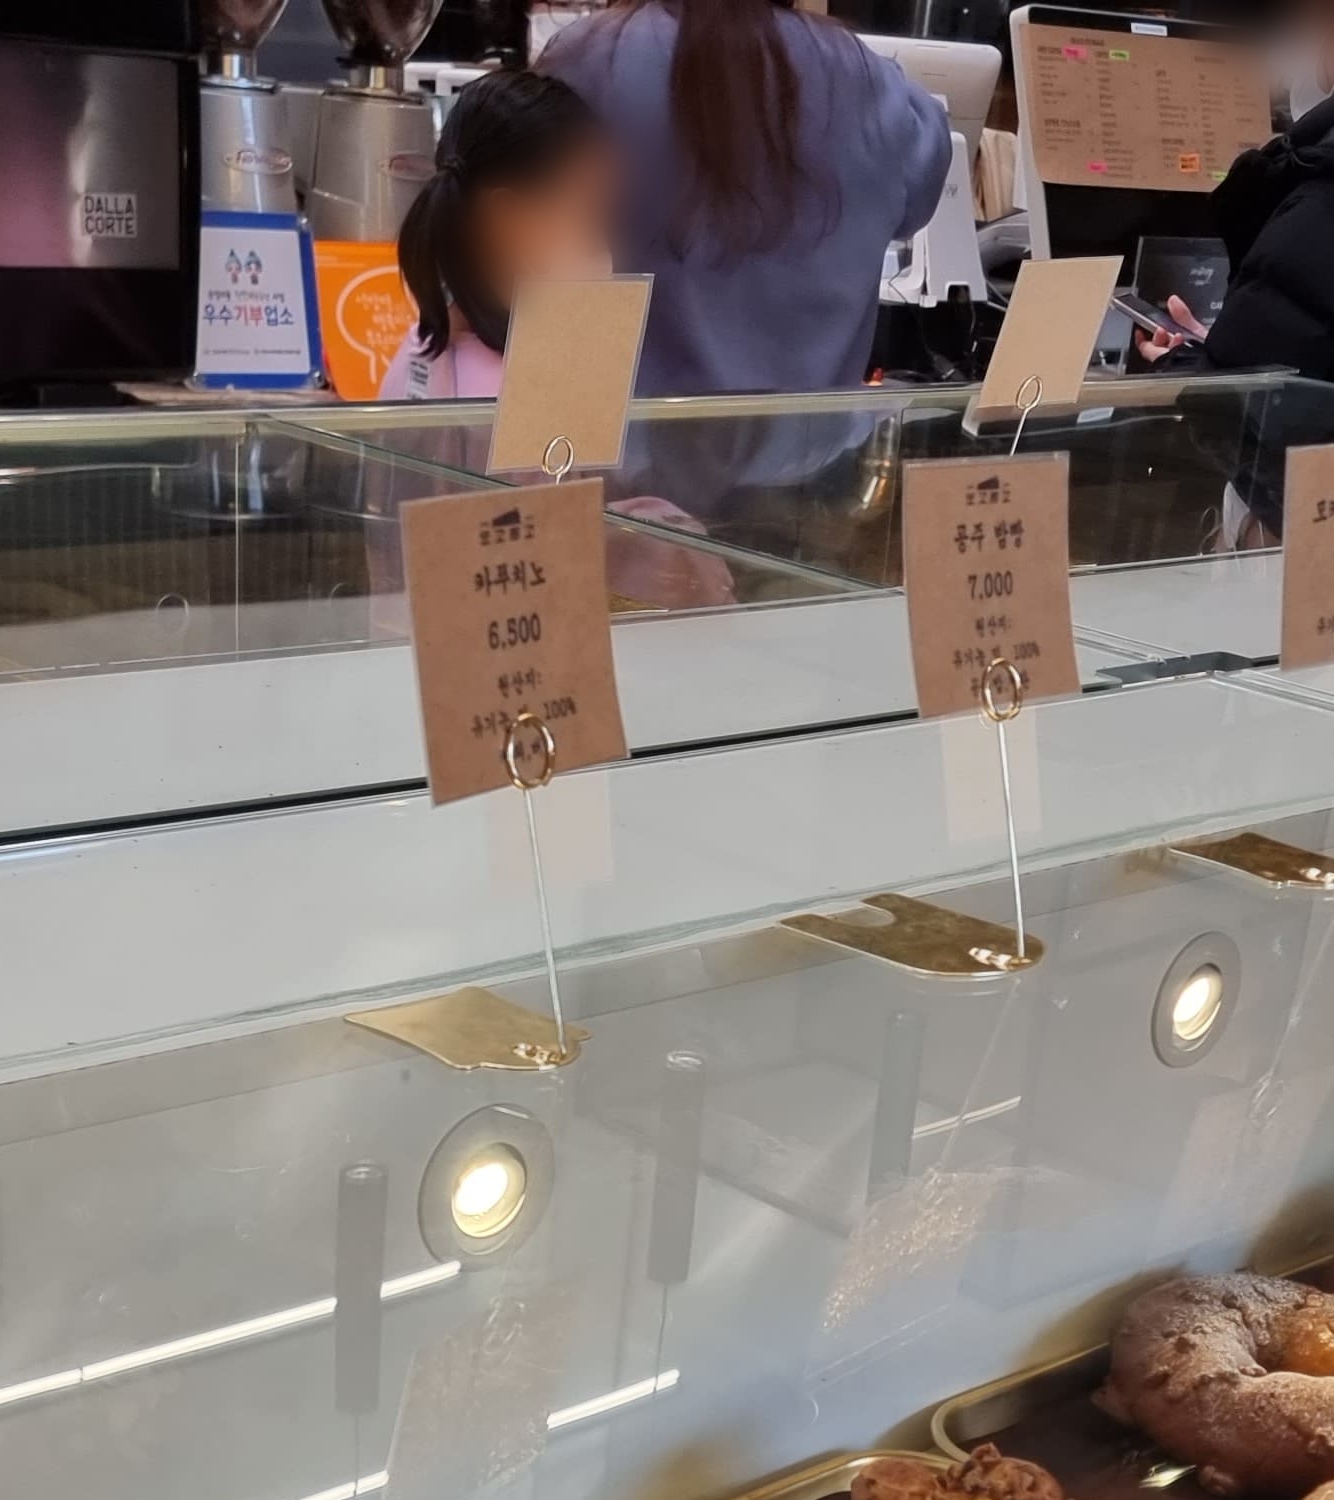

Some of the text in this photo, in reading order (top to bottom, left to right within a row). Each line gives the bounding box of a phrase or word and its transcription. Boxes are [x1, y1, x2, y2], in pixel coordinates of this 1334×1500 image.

[84, 195, 134, 214] DALLA
[84, 216, 134, 234] CORTE
[203, 303, 295, 327] 우수기부업소
[953, 522, 985, 555] 공주
